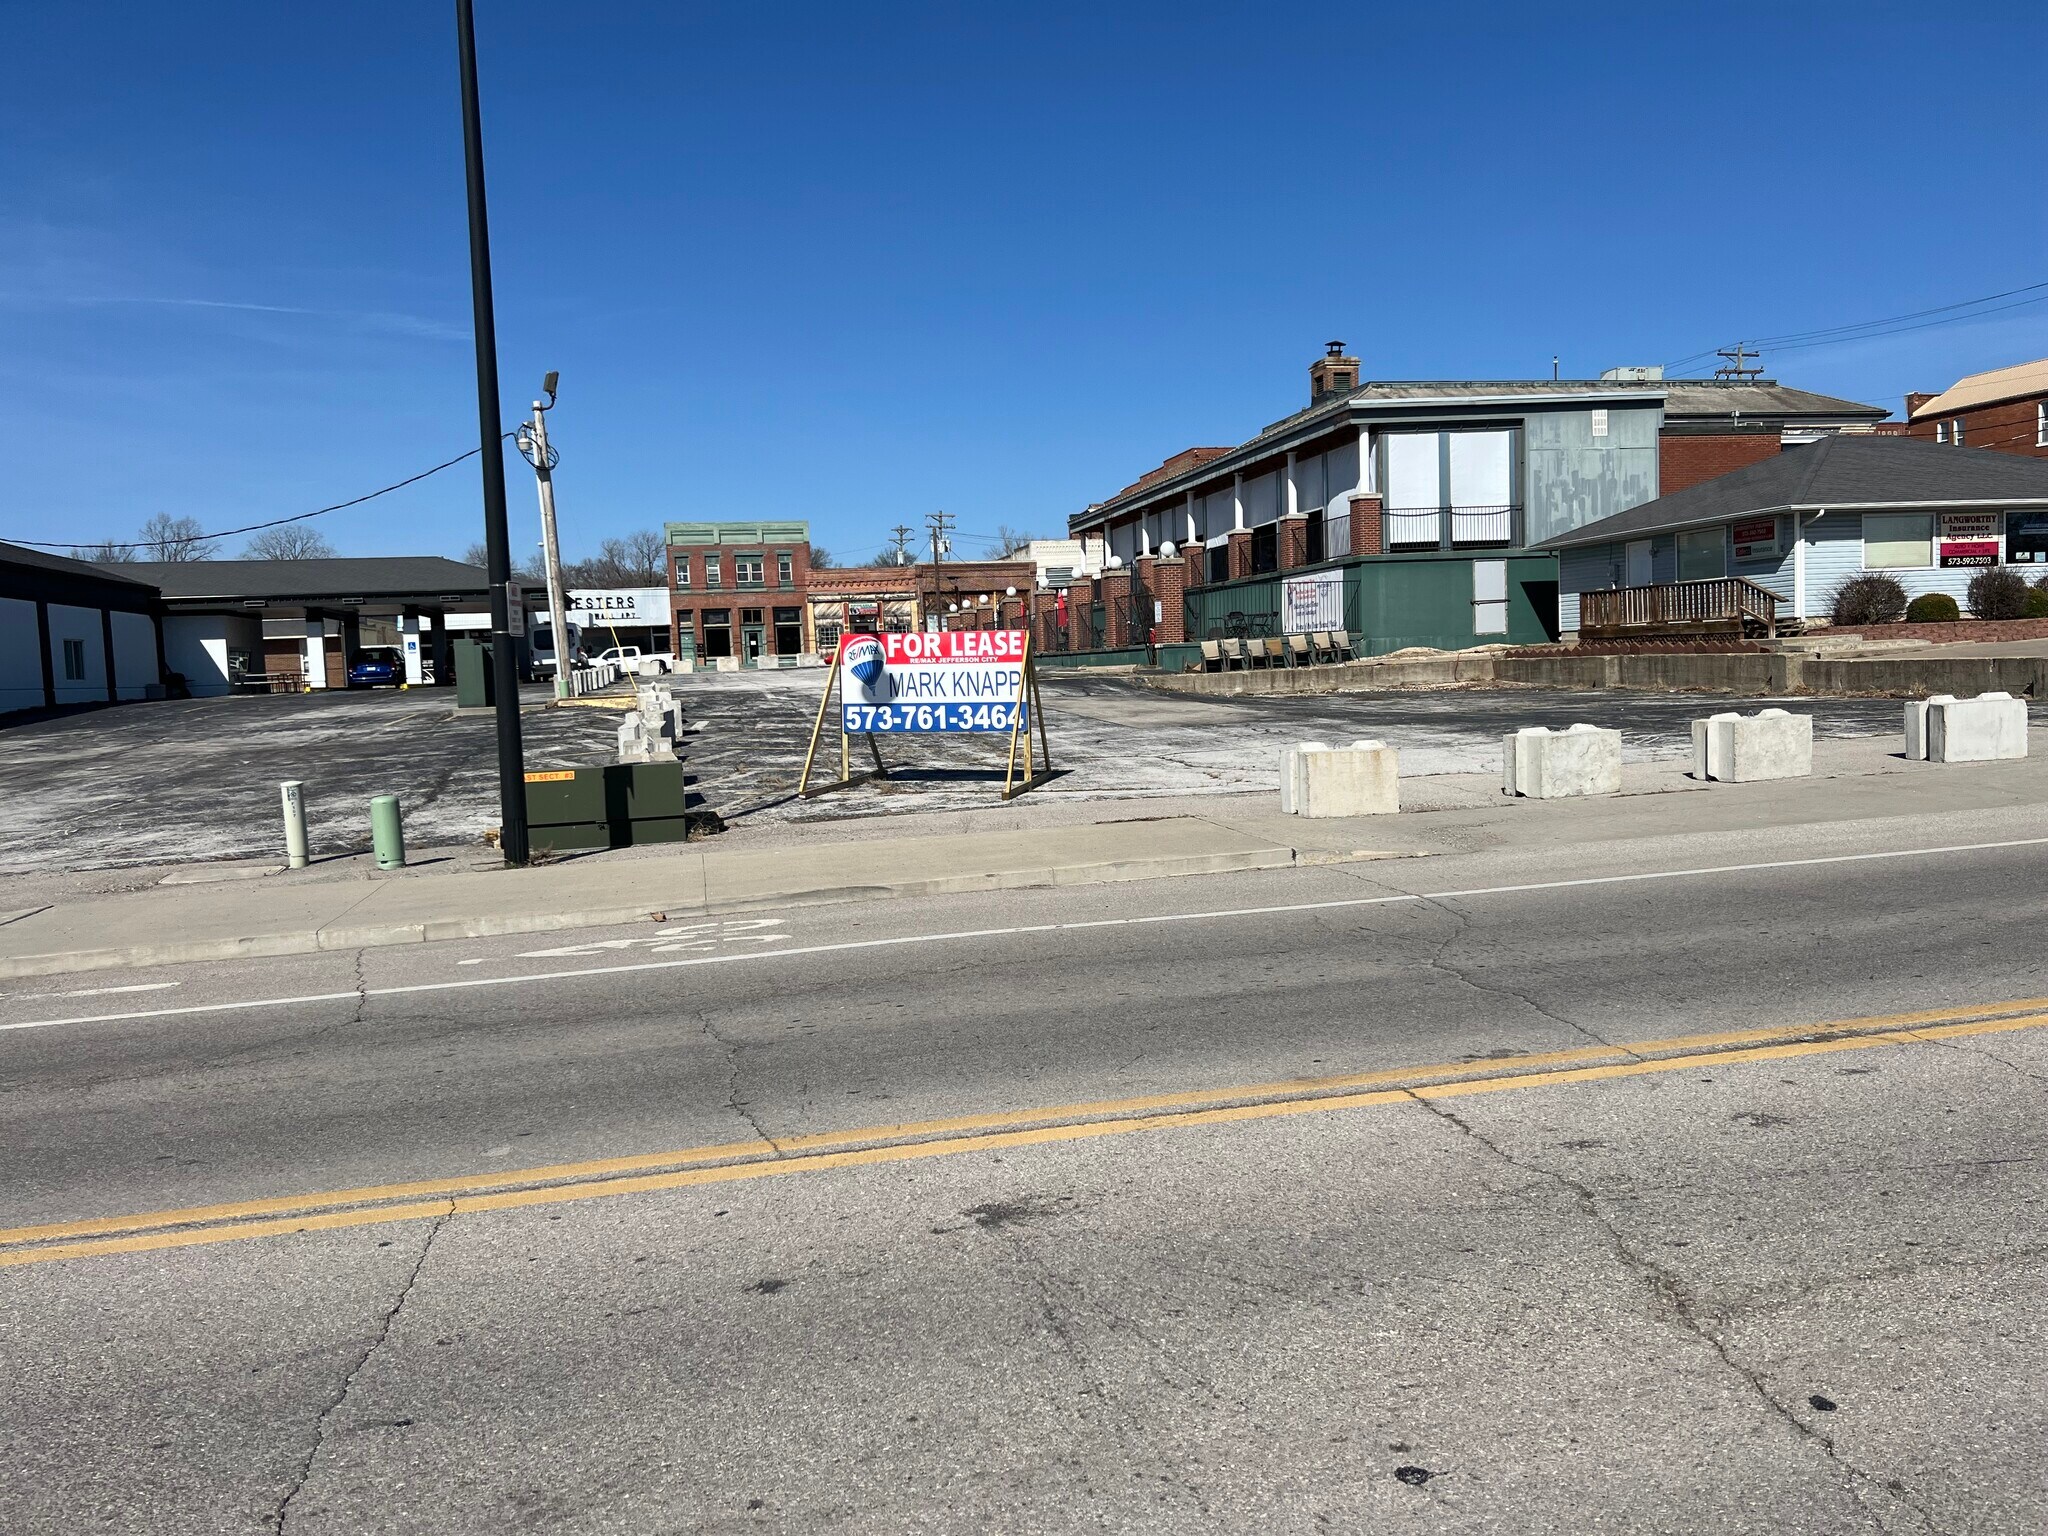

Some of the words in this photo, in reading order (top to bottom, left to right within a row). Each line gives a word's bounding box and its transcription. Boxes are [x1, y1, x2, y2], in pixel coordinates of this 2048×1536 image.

[1942, 515, 1997, 524] LANGWORTHY
[1949, 524, 1989, 532] Insurance
[1946, 533, 1976, 541] Agency
[1947, 557, 1991, 565] 573-592-7503
[887, 633, 942, 658] FOR
[950, 631, 1022, 656] LEASE
[848, 644, 880, 661] RE/MAX
[889, 672, 947, 697] MARK
[952, 671, 1021, 696] KNAPP
[846, 705, 1024, 730] 573-761-3464
